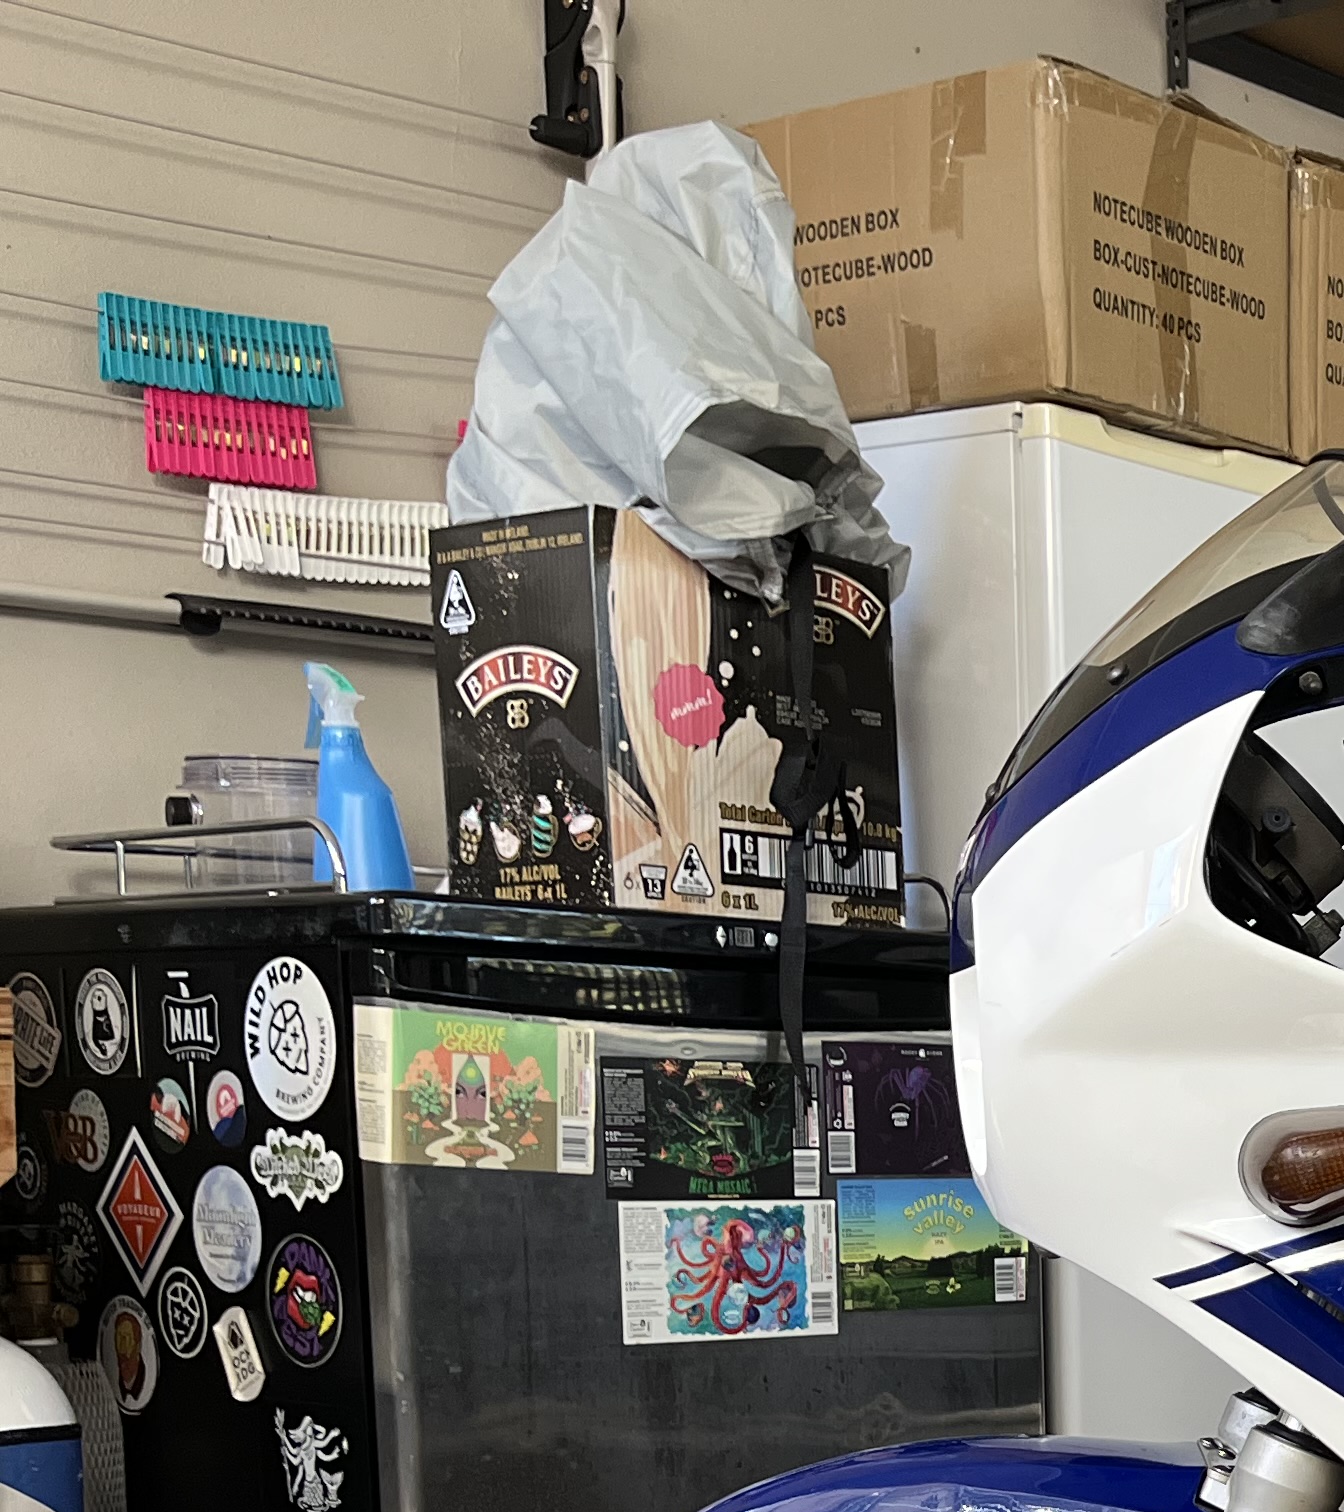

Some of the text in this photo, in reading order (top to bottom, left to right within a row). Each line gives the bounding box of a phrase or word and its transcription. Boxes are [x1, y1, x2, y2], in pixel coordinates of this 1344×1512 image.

[865, 208, 900, 233] BOX
[1092, 191, 1245, 268] NOTECUBE WOODEN BOX
[800, 247, 934, 288] OTECUBE-WOOD
[1093, 239, 1266, 320] BOX-CUST-NOTECUBE-WOOD
[814, 306, 846, 329] PCS
[1092, 287, 1202, 343] QUANTITY: 40 PCS
[466, 653, 566, 702] BAILEYS
[719, 802, 784, 827] Total Carton
[745, 837, 754, 854] 6
[623, 872, 634, 890] 6
[646, 878, 662, 893] 13
[721, 891, 730, 909] 6
[743, 893, 759, 911] 1L
[168, 1005, 214, 1044] NAIL
[247, 961, 303, 1060] WILD HOP
[436, 1020, 507, 1042] MOJAVE
[904, 1189, 974, 1220] sunrise
[913, 1209, 965, 1234] valley
